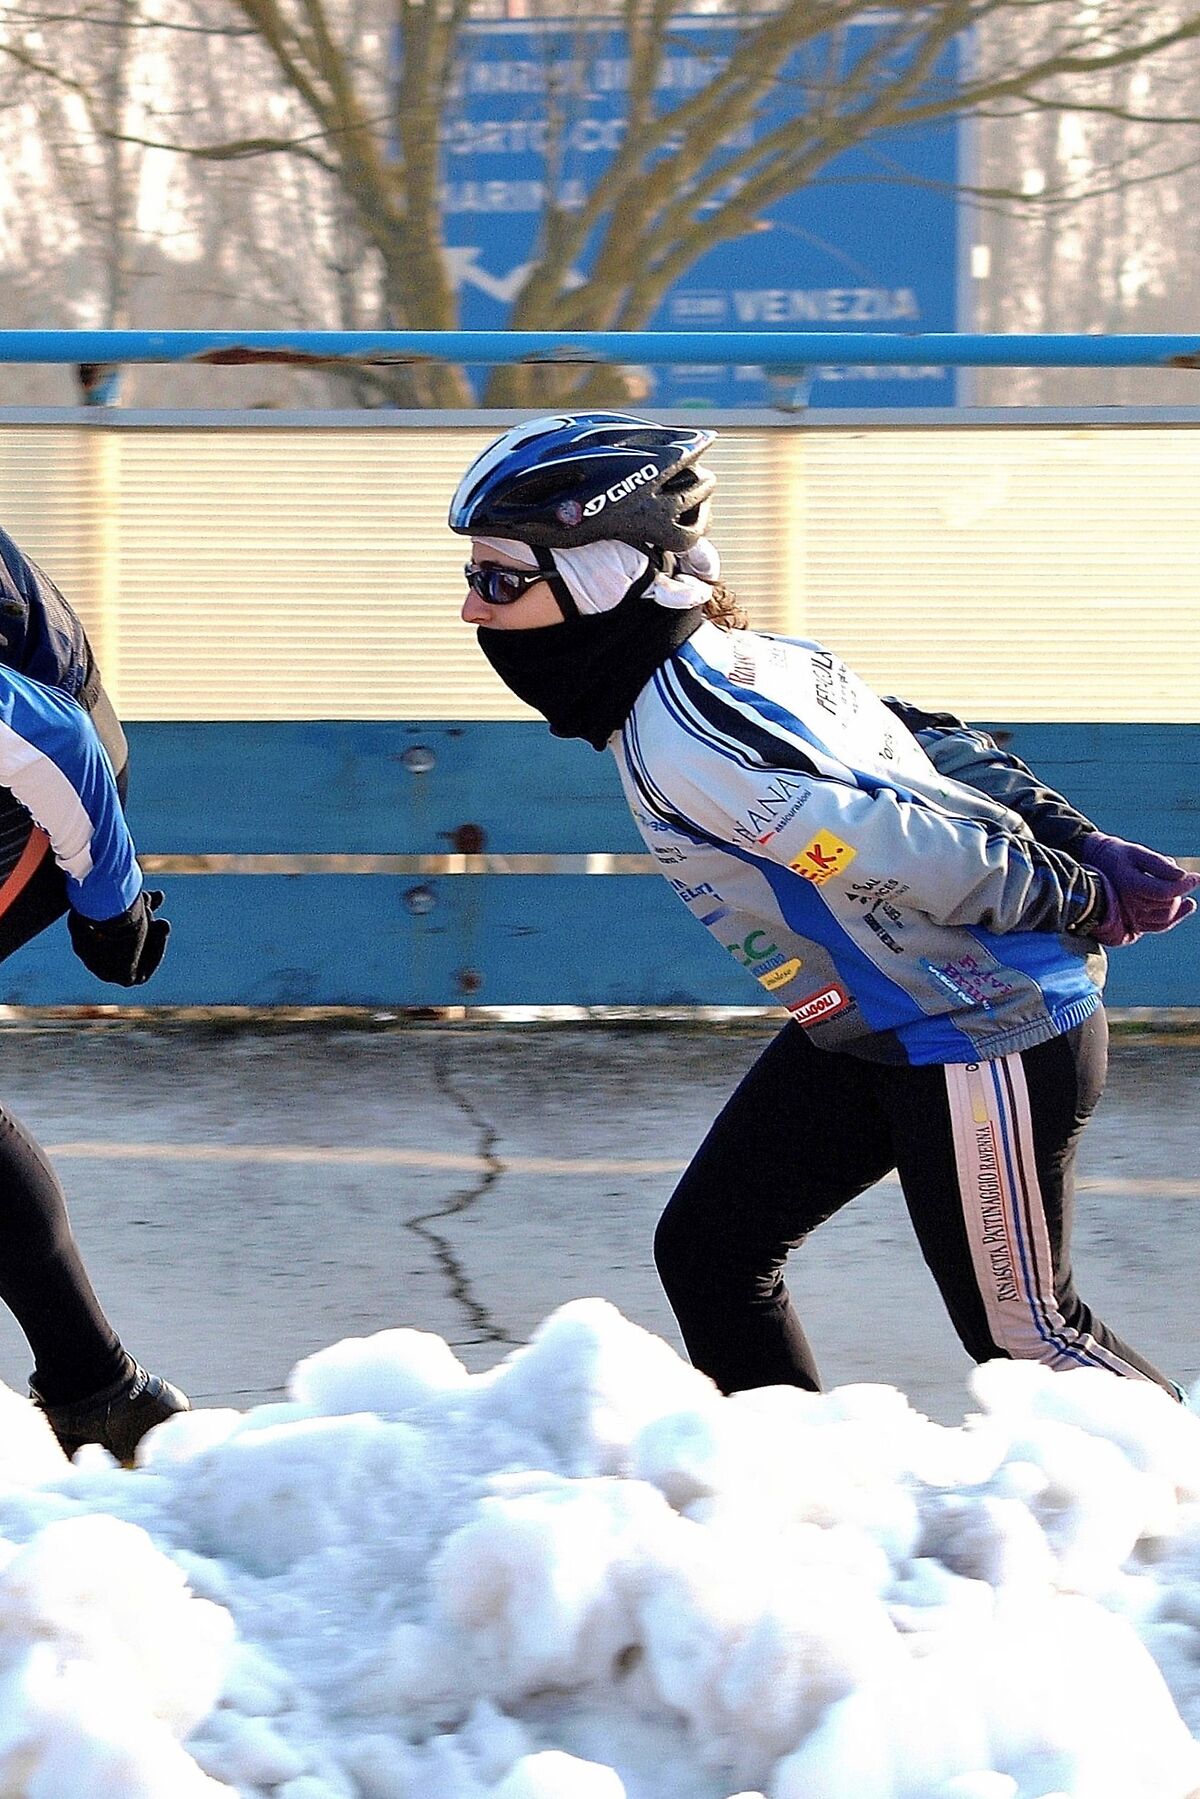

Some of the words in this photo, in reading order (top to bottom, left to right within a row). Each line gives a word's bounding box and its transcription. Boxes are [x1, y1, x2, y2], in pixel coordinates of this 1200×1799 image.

[734, 289, 919, 322] VENEZIA
[606, 463, 659, 502] GIRO
[976, 1126, 998, 1170] RAVENNA
[977, 1173, 1008, 1245] PATTINAGGIO
